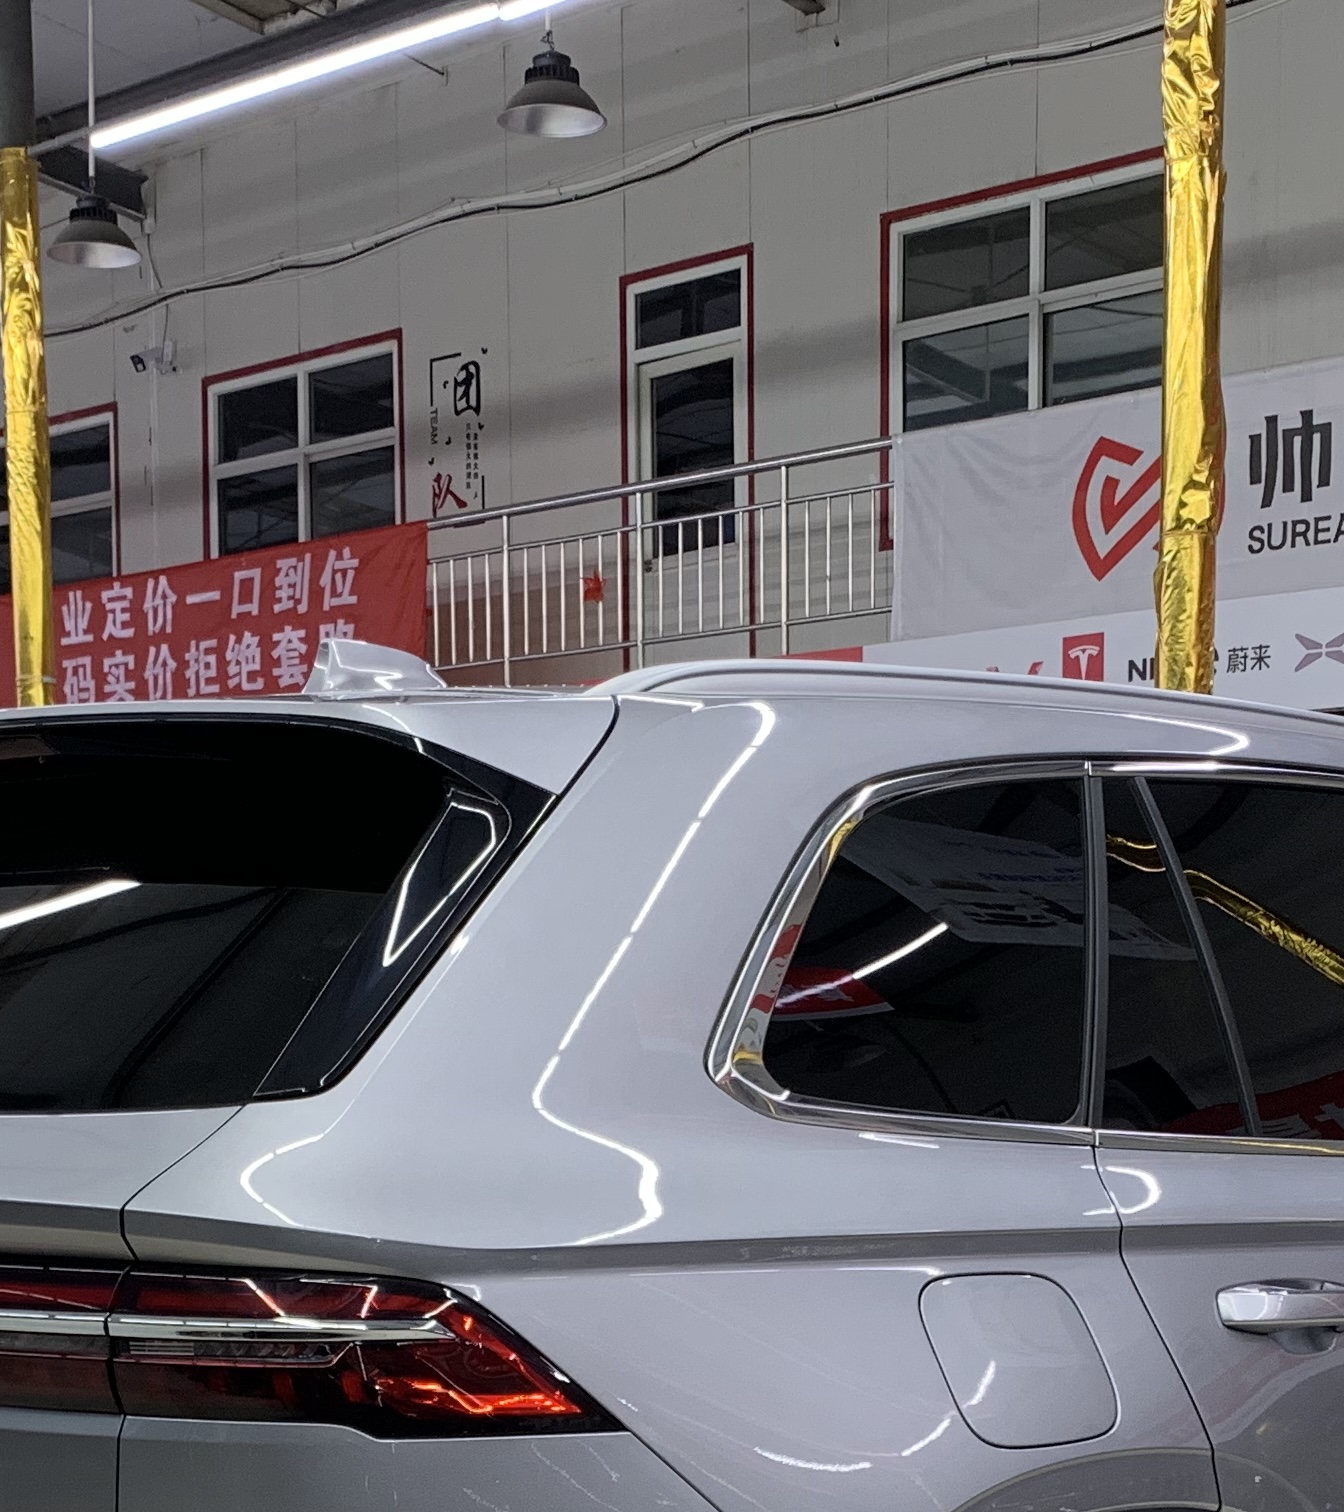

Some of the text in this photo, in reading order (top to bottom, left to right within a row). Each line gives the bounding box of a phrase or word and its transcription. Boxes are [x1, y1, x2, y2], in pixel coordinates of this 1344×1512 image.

[430, 408, 439, 445] TEAM
[61, 545, 360, 646] 业定价一口到位
[1226, 644, 1272, 675] 蔚来
